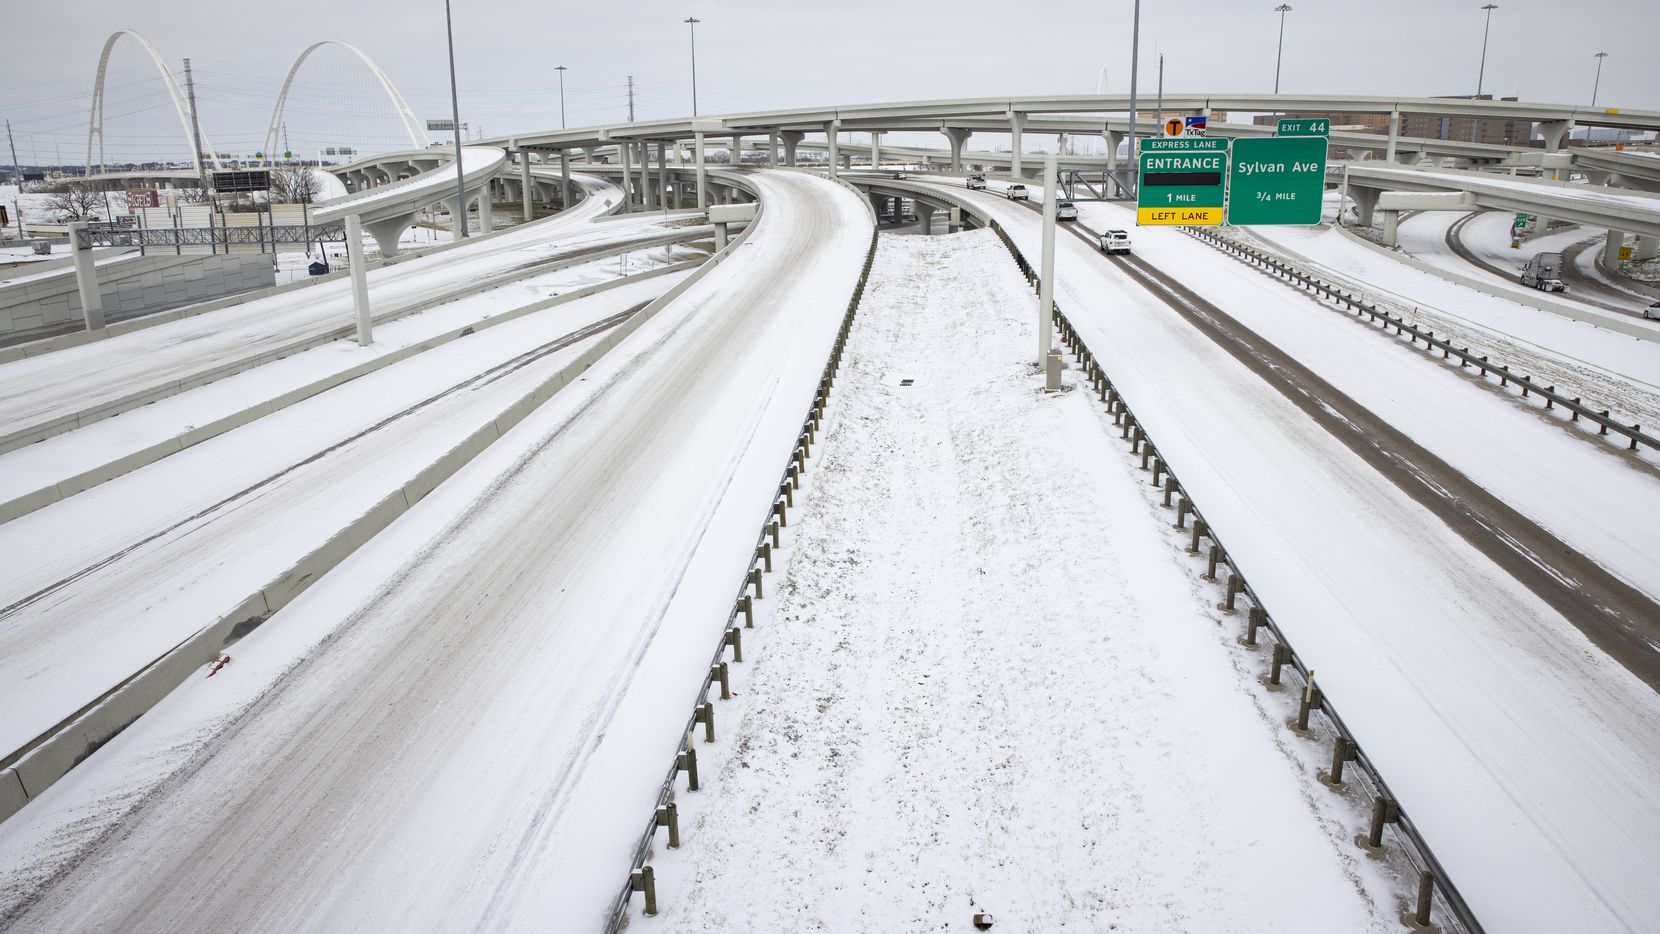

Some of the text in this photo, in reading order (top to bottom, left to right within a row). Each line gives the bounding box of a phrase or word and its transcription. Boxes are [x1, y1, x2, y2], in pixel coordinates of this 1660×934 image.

[1169, 120, 1180, 136] T
[1185, 129, 1206, 137] TxTag
[1282, 122, 1325, 133] EXIT 44
[1152, 141, 1217, 149] EXPRESS LANE
[1146, 158, 1220, 169] ENTRANCE
[1238, 161, 1318, 176] Sylvan Ave
[1166, 193, 1196, 203] 1 MILE
[1256, 191, 1296, 202] 3/4 MILE
[1151, 212, 1209, 220] LEFT LANE
